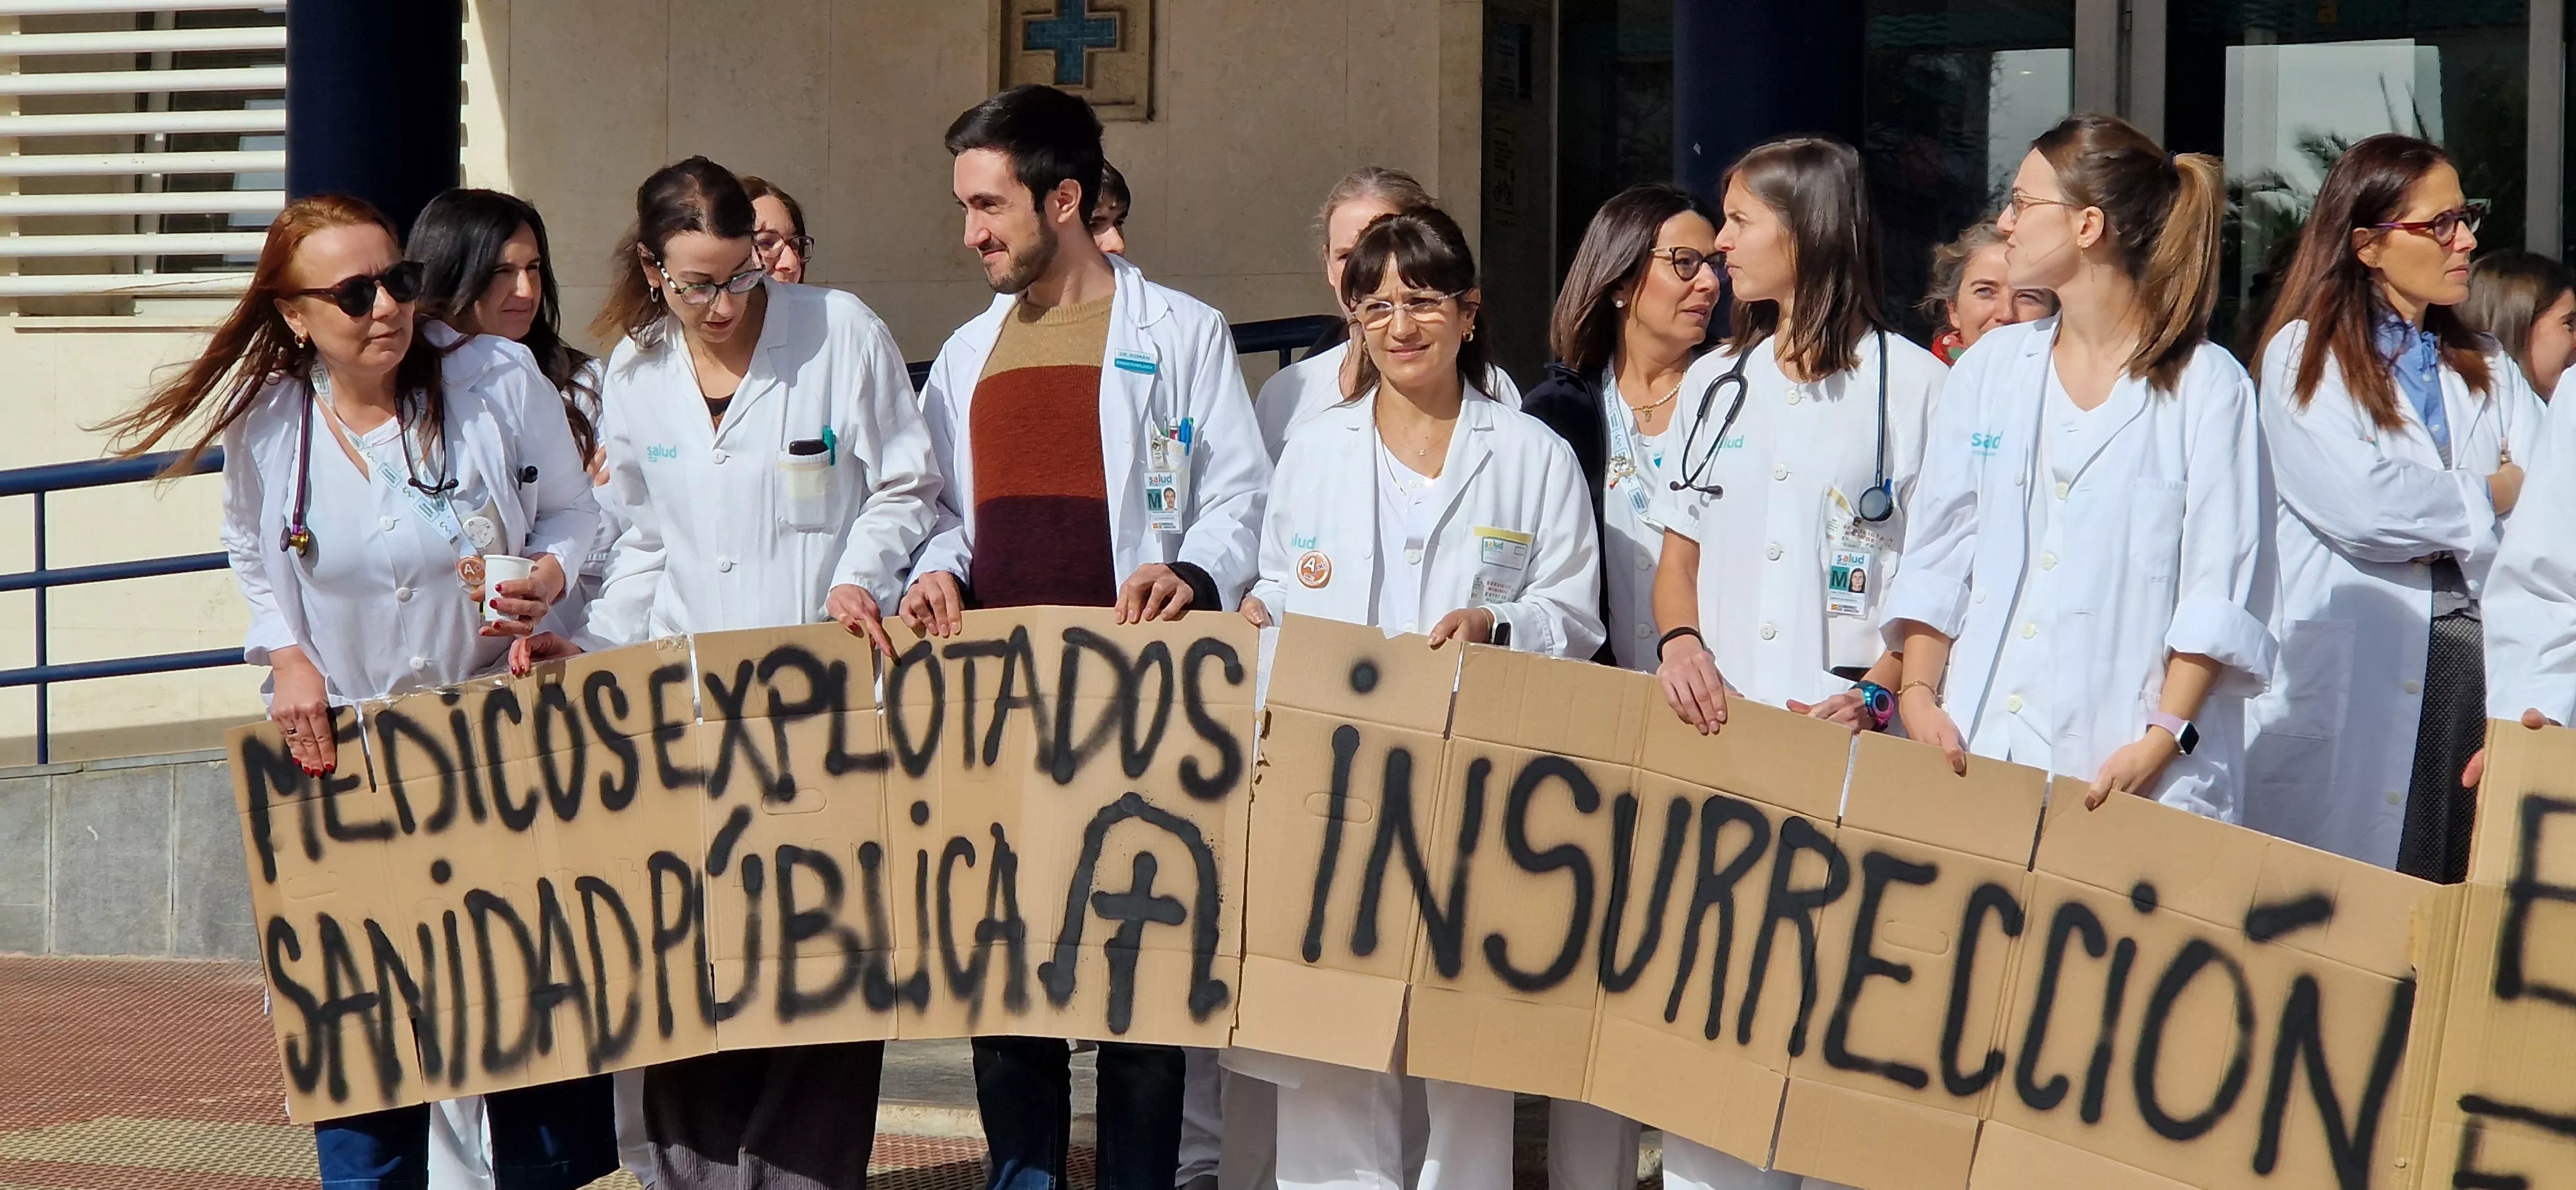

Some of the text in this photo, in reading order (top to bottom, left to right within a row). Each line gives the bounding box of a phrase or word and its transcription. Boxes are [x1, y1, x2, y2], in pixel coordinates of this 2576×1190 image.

[647, 443, 676, 459] salud
[1148, 473, 1173, 484] salud
[1148, 493, 1161, 509] M
[1837, 553, 1865, 565] salud
[1831, 570, 1848, 588] M
[648, 625, 1245, 802] EXPLOTADOS
